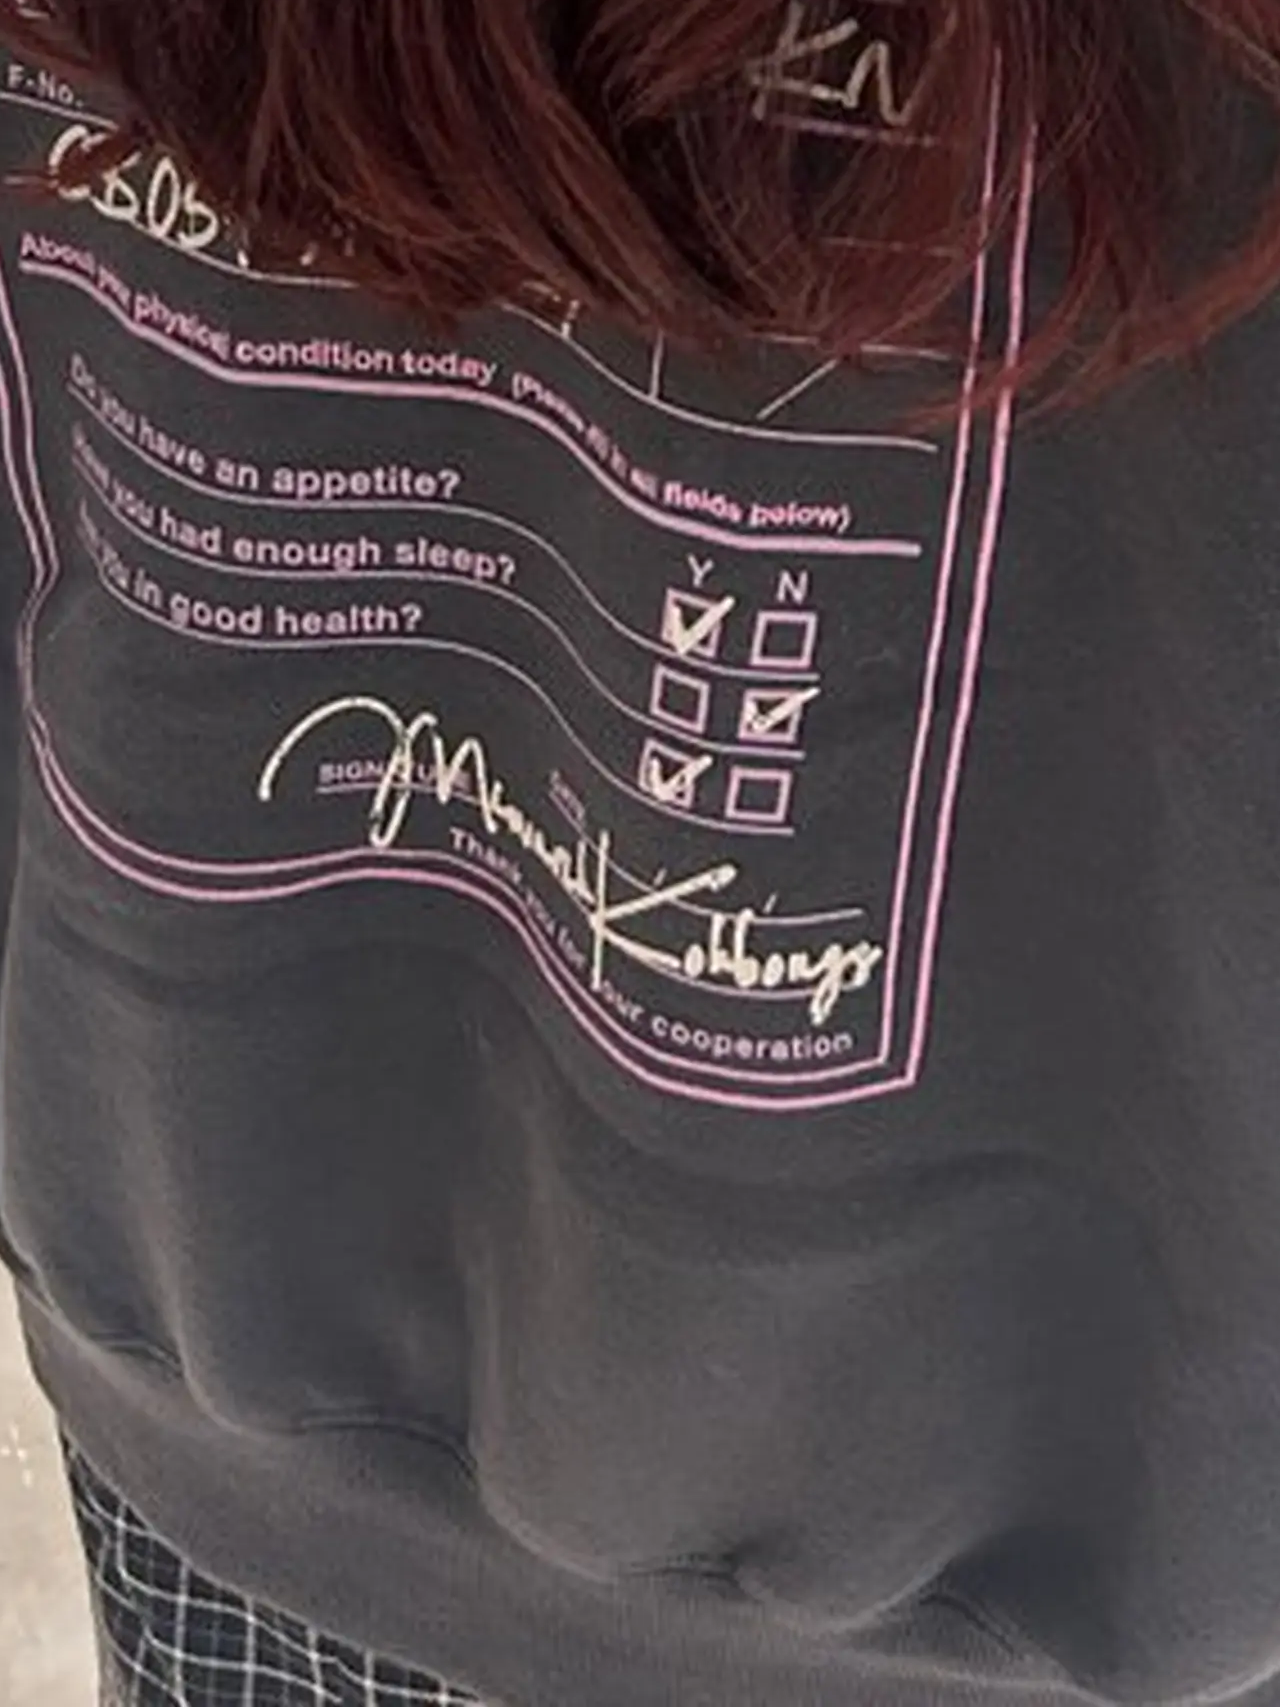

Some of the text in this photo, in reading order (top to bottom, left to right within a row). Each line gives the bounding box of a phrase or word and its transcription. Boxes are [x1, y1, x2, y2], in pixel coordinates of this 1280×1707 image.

[134, 290, 230, 361] physical
[234, 336, 394, 374] condition
[401, 347, 498, 387] today
[662, 480, 742, 523] fields
[748, 500, 852, 535] below)
[138, 415, 207, 476] have
[214, 457, 260, 490] an
[272, 465, 462, 501] appetite?
[159, 506, 223, 555] had
[232, 535, 382, 572] enough
[394, 537, 516, 586] sleep?
[687, 552, 809, 604] Y N
[133, 567, 163, 608] in
[169, 592, 263, 635] good
[275, 602, 423, 636] health?
[596, 976, 645, 1023] our
[650, 1013, 853, 1060] cooperation
